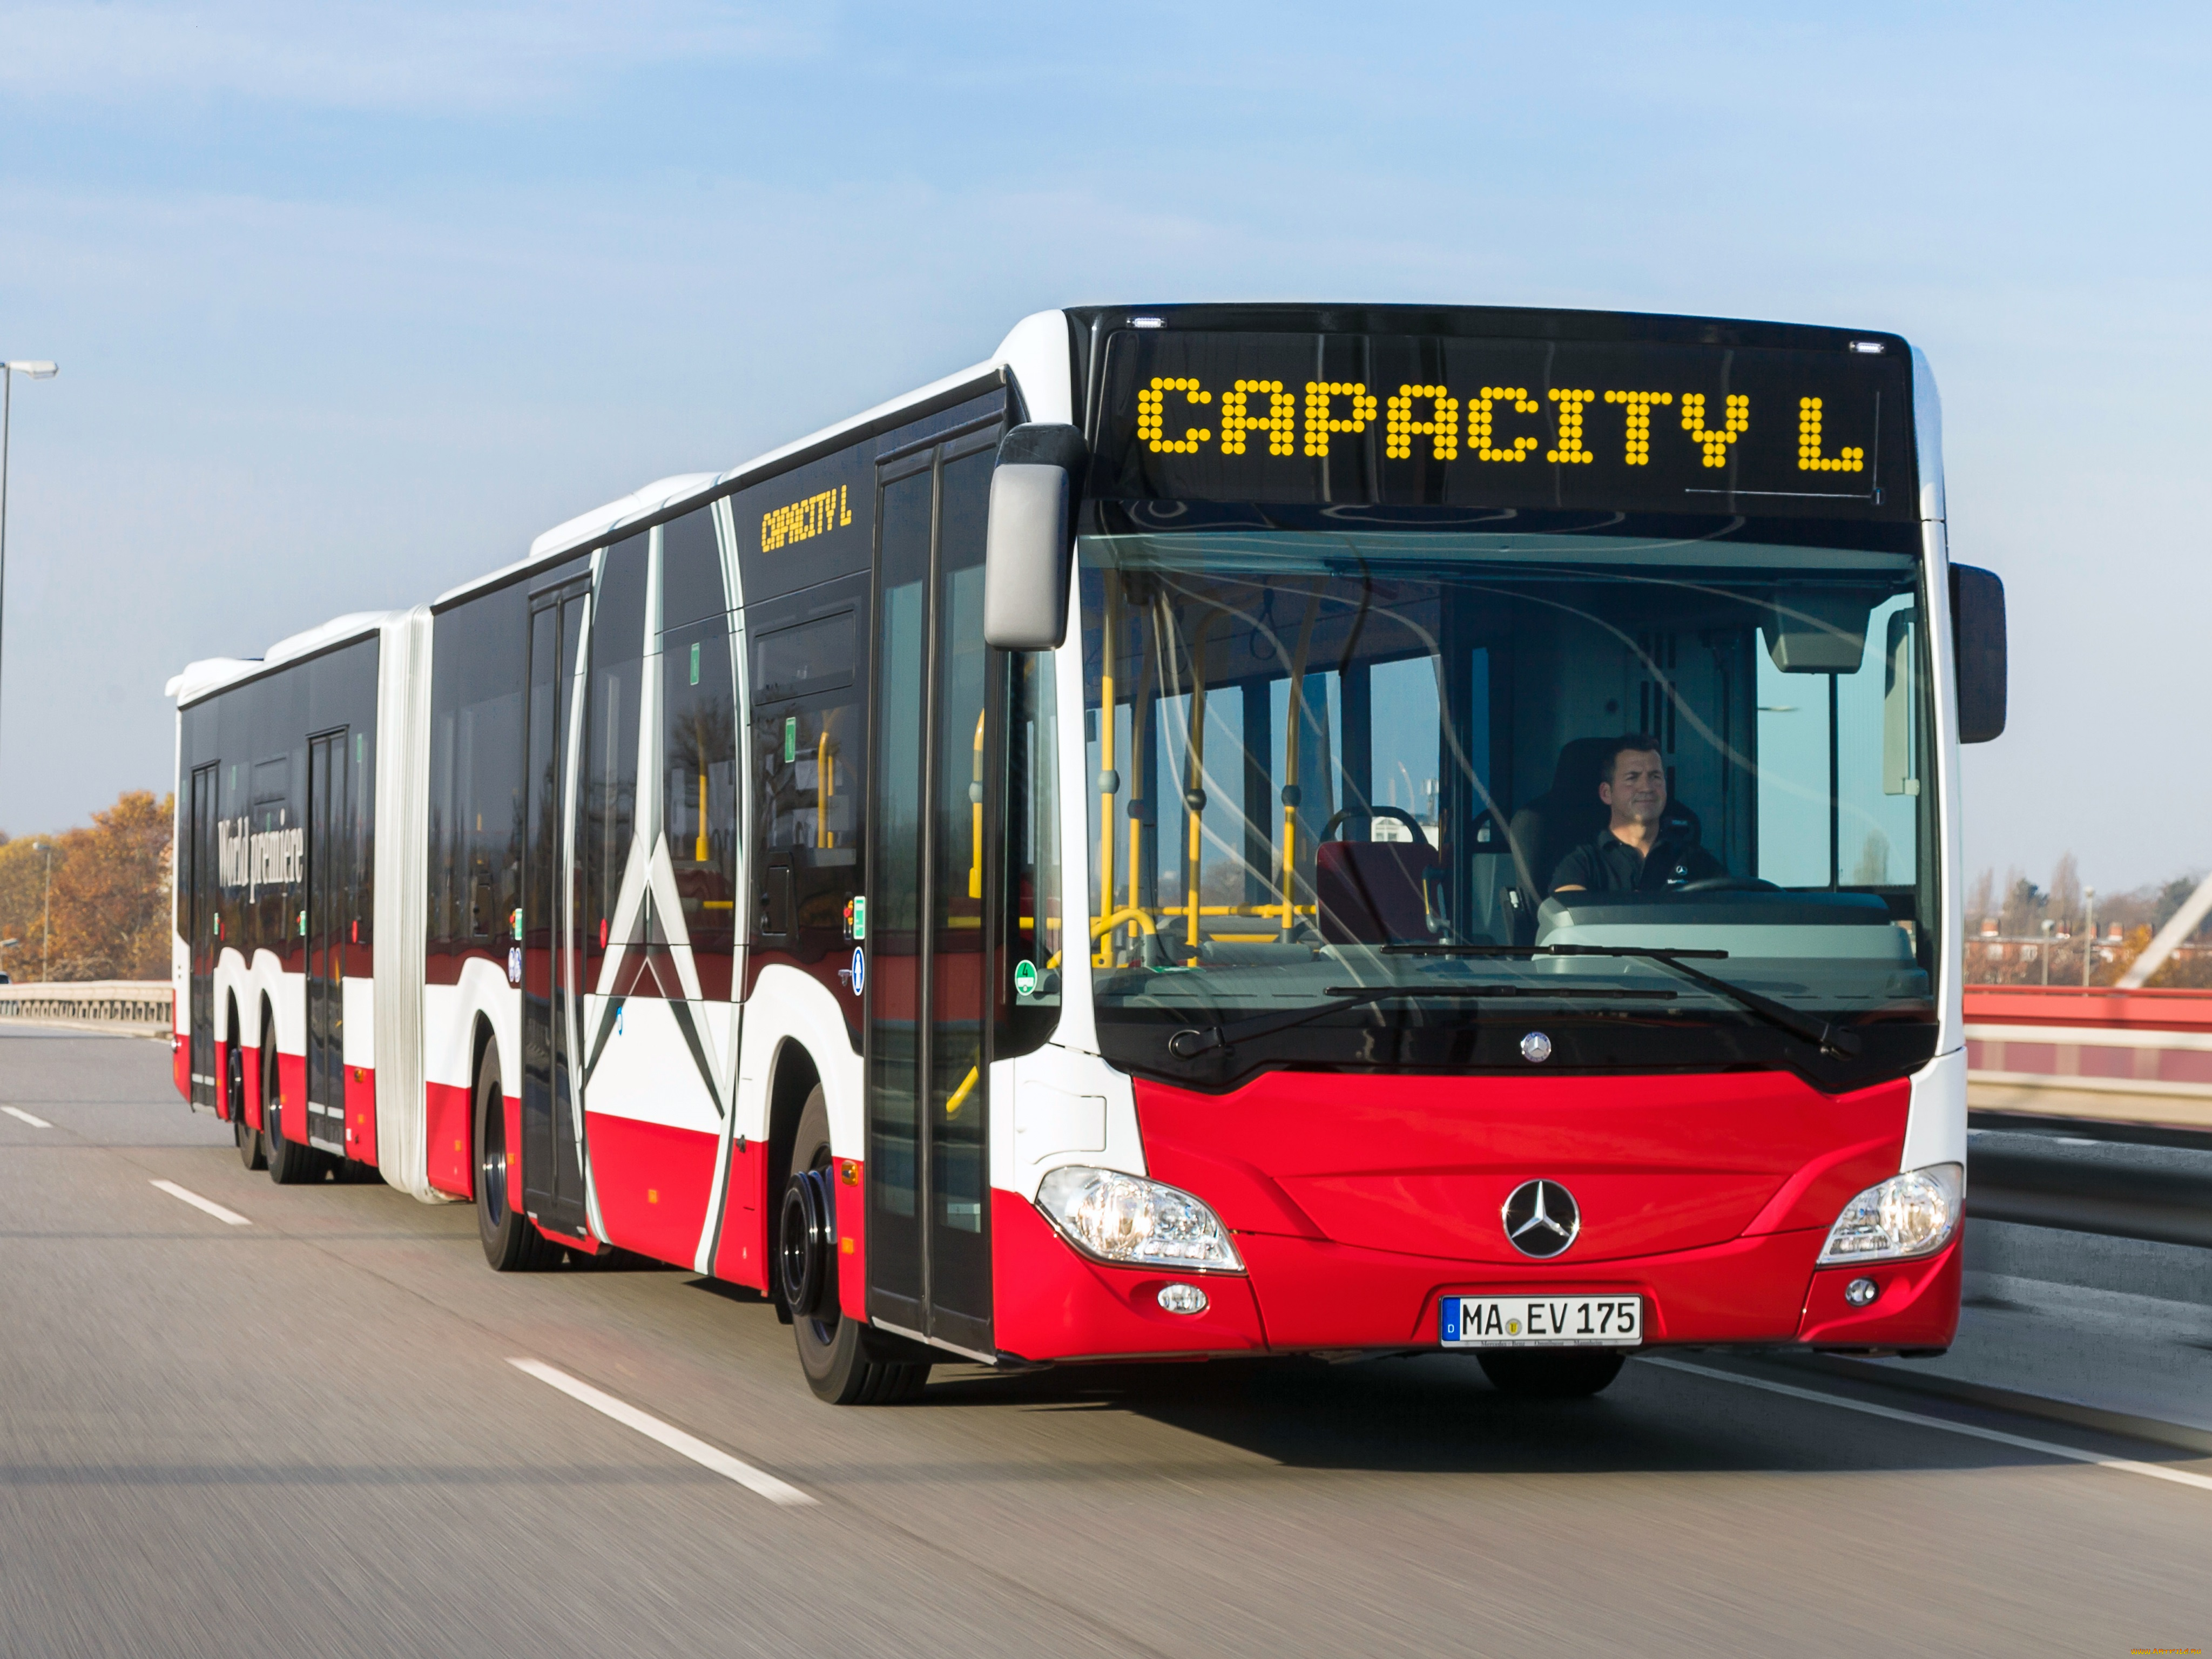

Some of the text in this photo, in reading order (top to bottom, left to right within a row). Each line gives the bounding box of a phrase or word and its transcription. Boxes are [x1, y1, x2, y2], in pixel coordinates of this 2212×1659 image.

[1137, 377, 1864, 472] CAPACITY L
[761, 484, 852, 553] CAPACITY L
[218, 808, 304, 905] World premiere
[1022, 963, 1028, 977] 4
[1447, 1302, 1635, 1335] D MA EV 175
